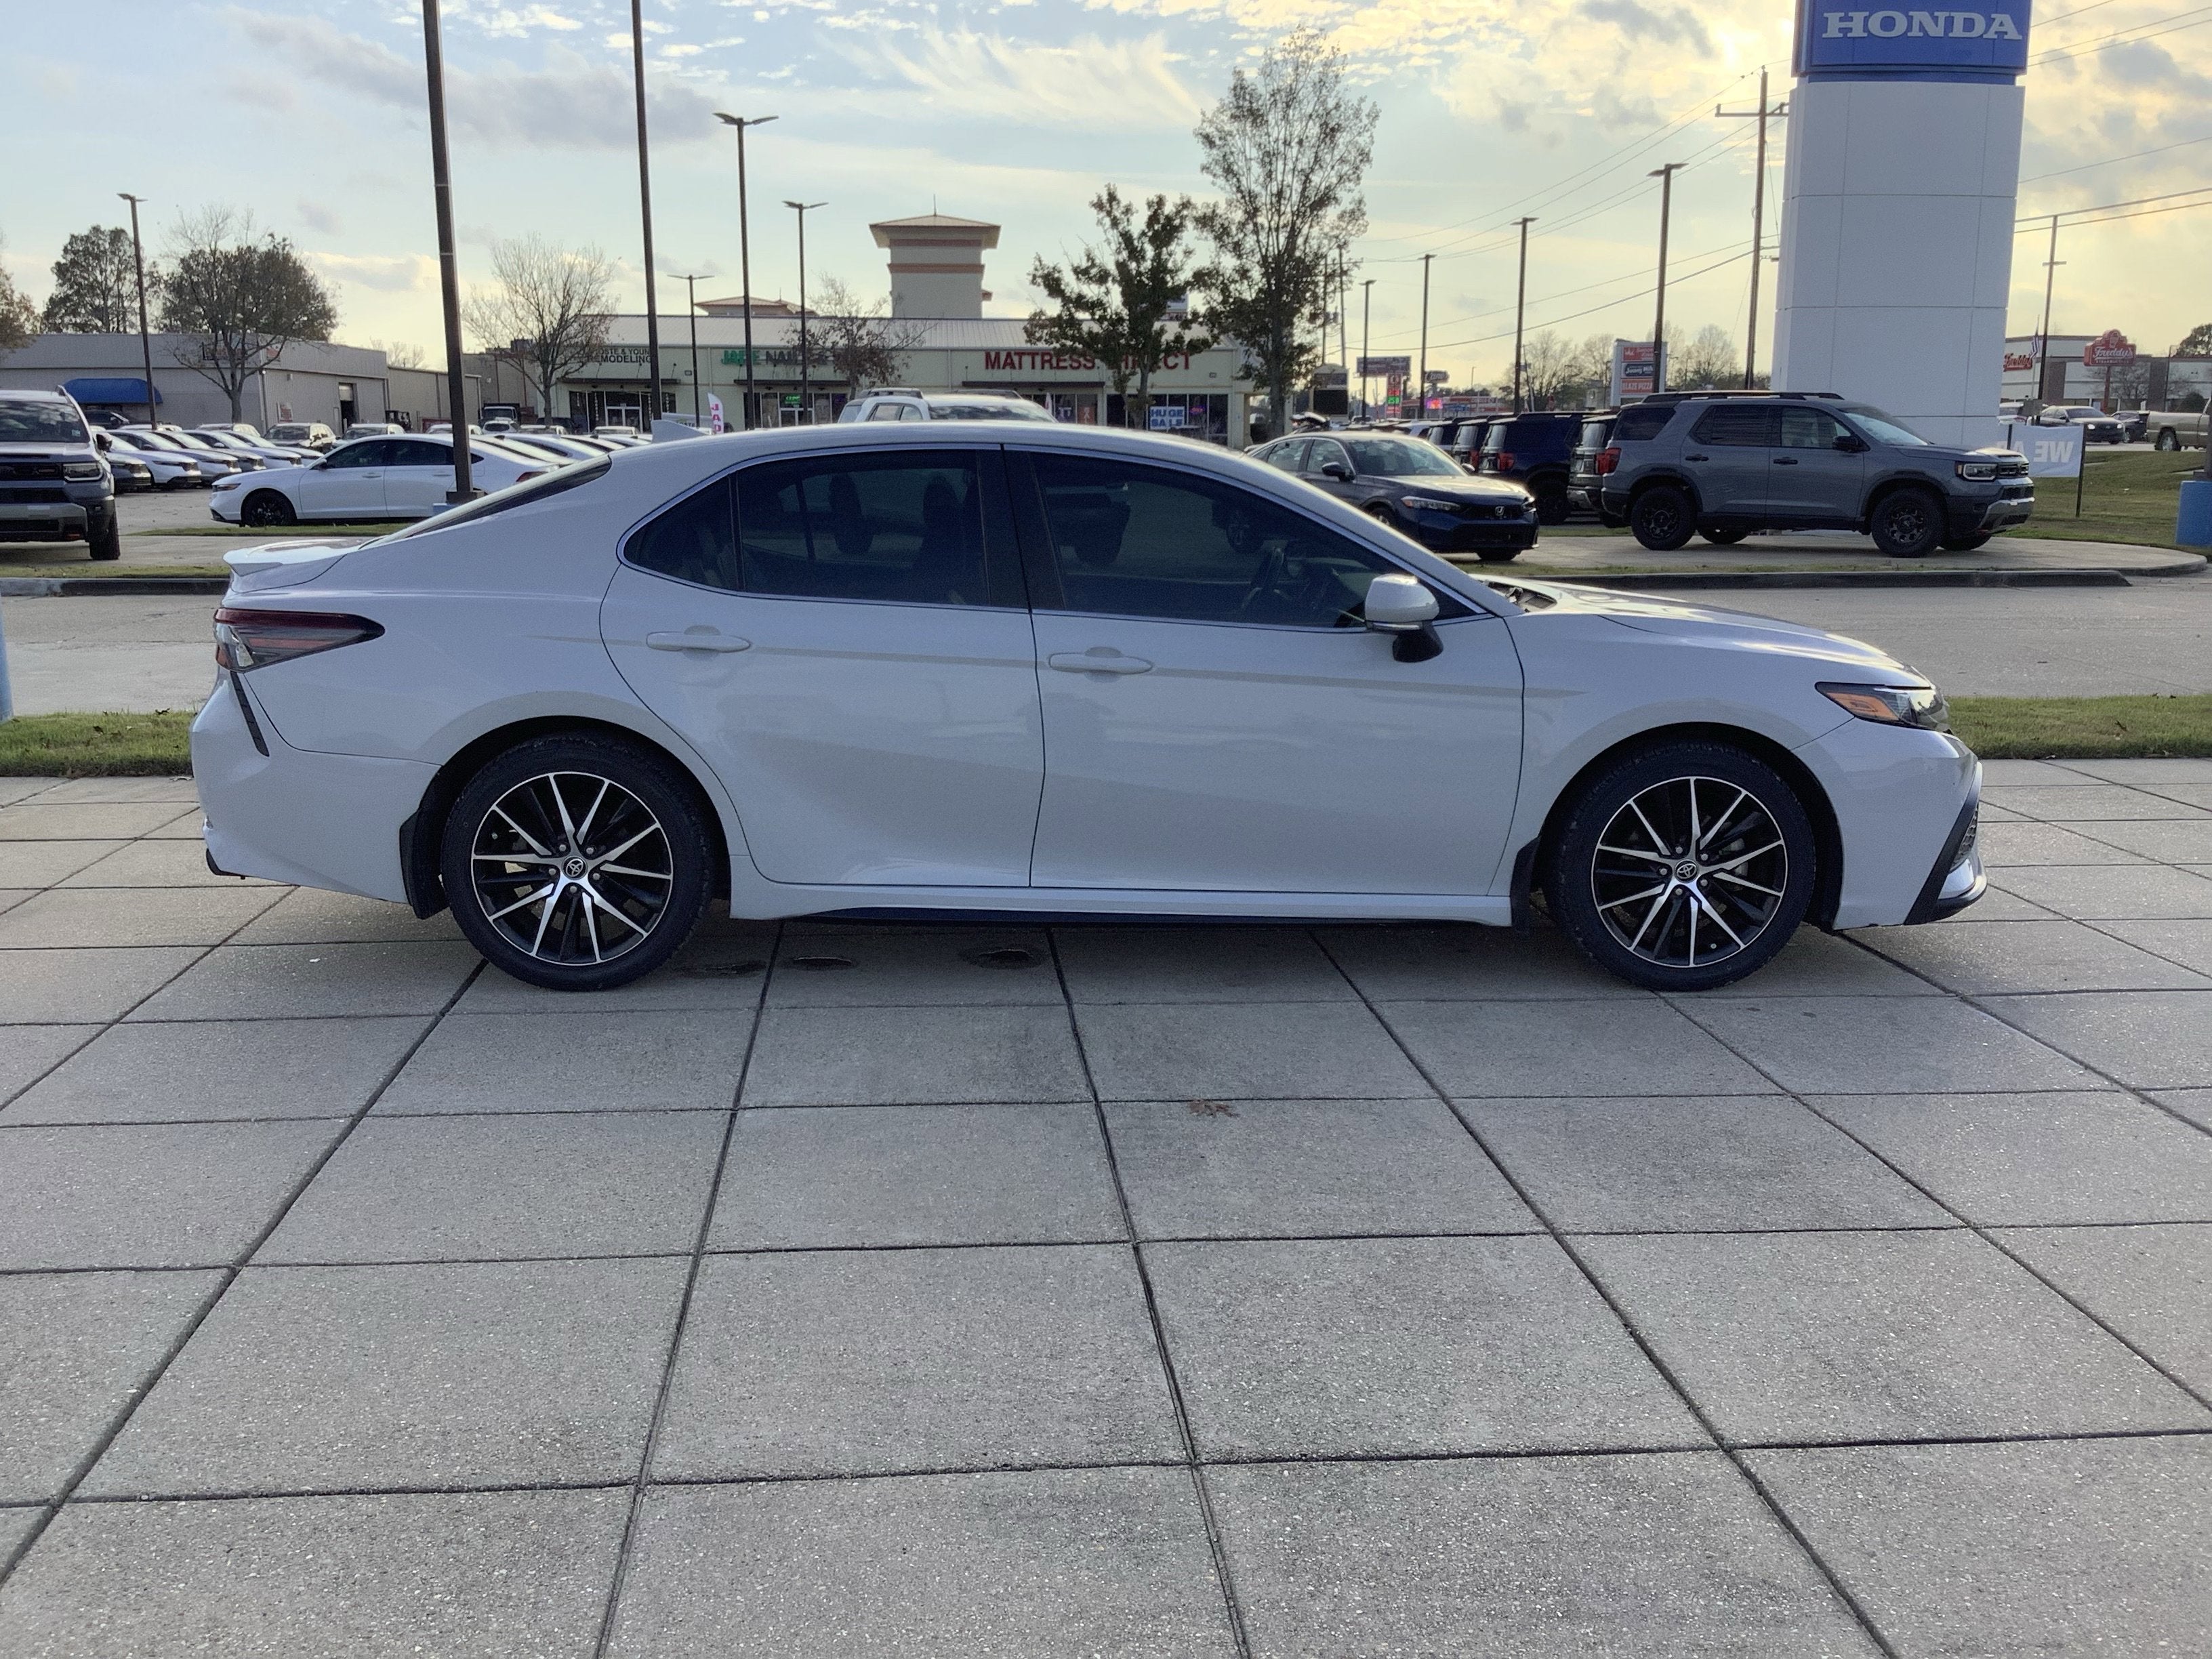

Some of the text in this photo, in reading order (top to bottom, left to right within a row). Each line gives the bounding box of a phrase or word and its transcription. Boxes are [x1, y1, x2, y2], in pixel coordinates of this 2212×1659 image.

[1822, 11, 2023, 40] HONDA
[2092, 346, 2133, 359] Freddy's
[984, 351, 1095, 369] MATTRESS
[1151, 409, 1183, 417] HUGE
[1151, 418, 1183, 427] SALE
